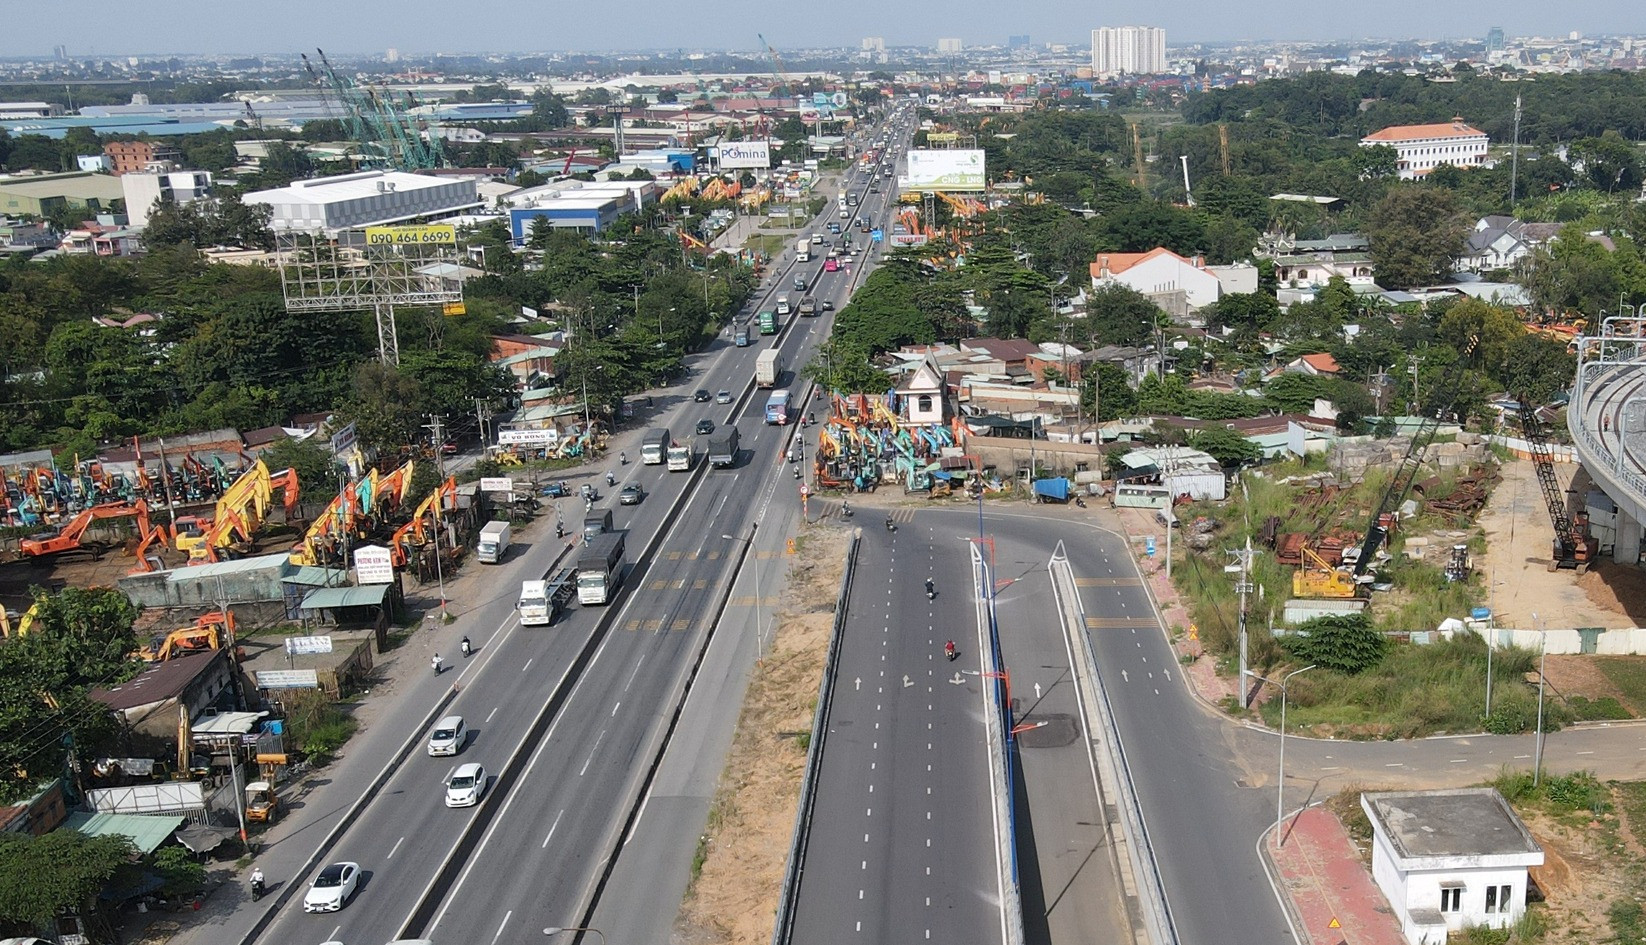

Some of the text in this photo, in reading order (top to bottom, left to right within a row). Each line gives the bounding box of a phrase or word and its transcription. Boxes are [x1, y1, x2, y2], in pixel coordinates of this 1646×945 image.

[941, 176, 960, 184] CNG
[371, 231, 451, 244] 090 464 6699
